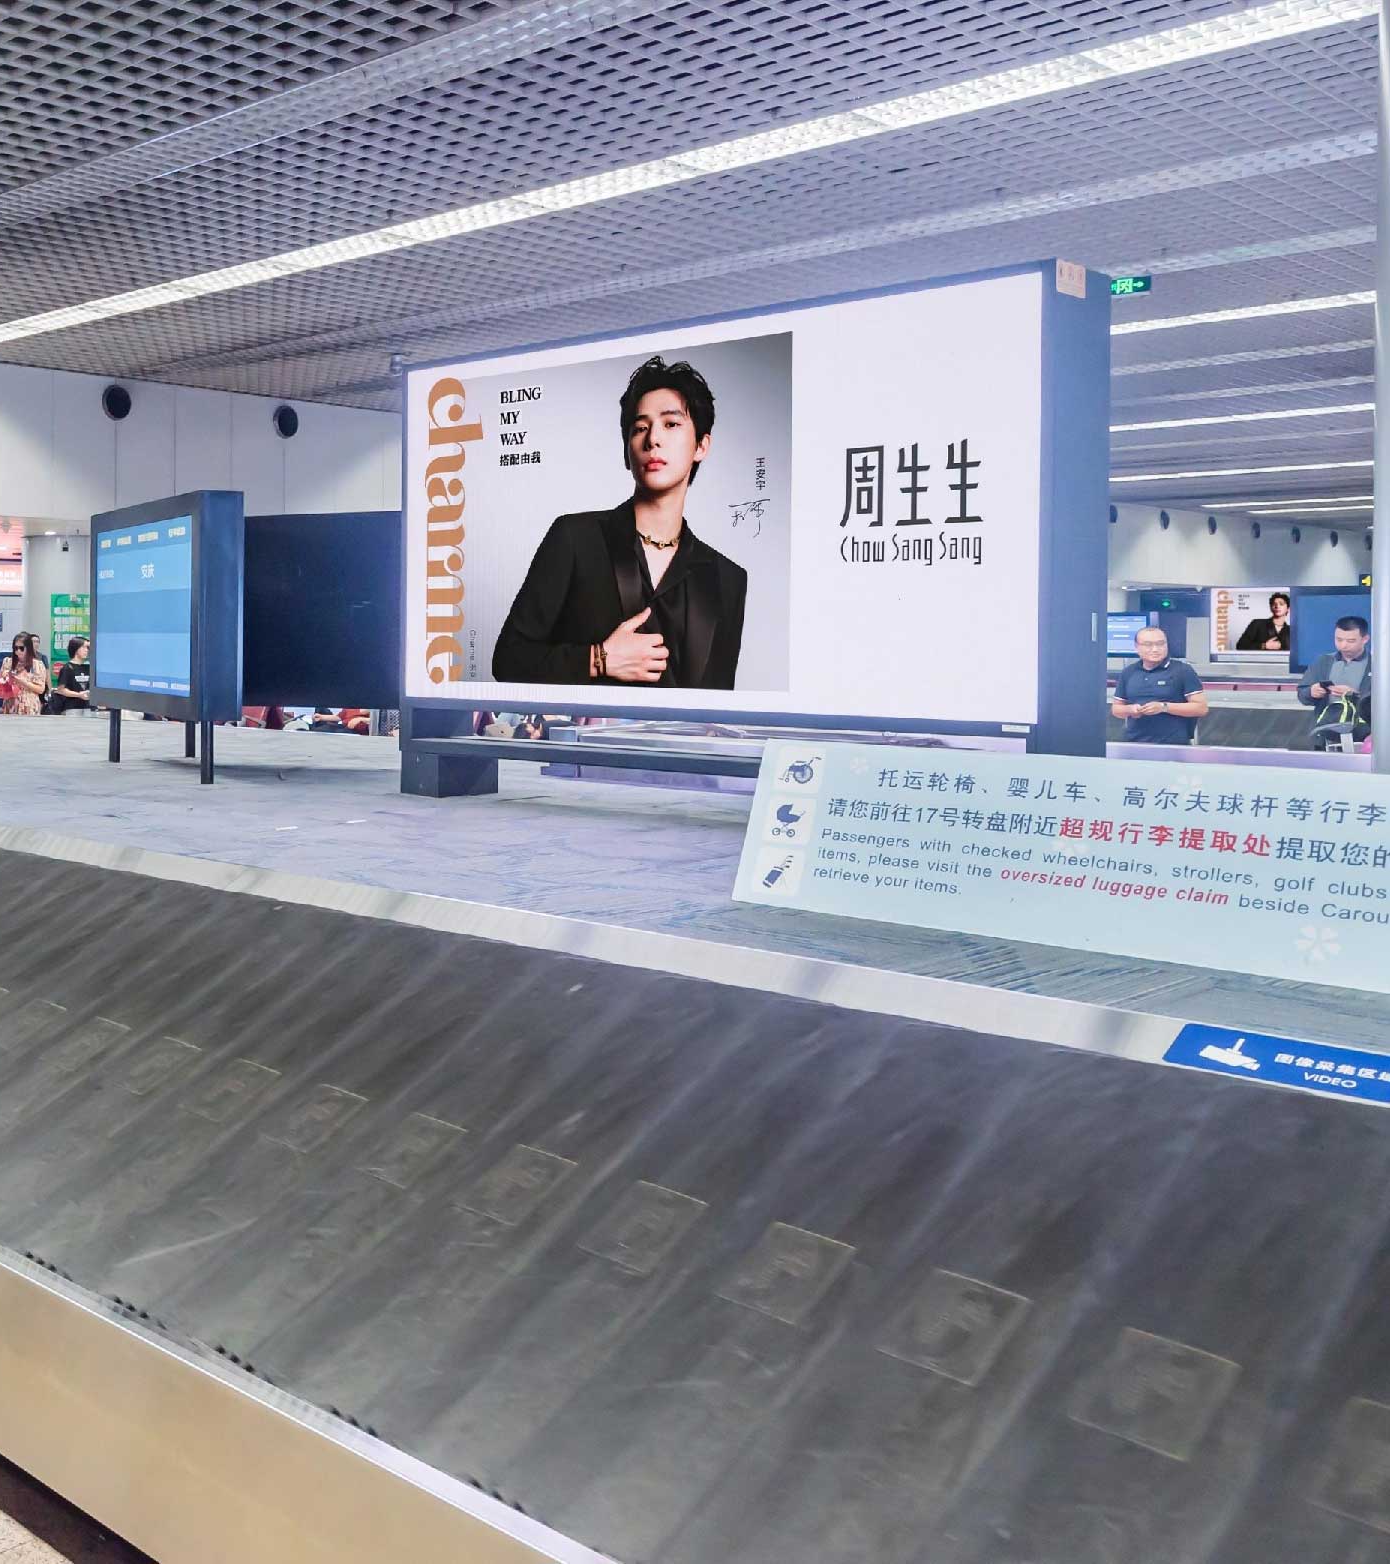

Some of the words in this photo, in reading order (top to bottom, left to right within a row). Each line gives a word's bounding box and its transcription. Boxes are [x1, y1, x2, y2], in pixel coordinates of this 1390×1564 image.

[500, 386, 542, 404] BLING
[499, 410, 520, 425] MY
[499, 431, 527, 446] WAY
[499, 451, 541, 467] 搭配由我
[839, 438, 984, 528] 周生生
[425, 376, 483, 685] charme
[840, 536, 885, 563] Chow
[892, 531, 933, 566] Sang
[939, 531, 982, 565] Sang
[877, 768, 1387, 827] 托运轮椅、婴儿车、高尔夫球杆等行李
[821, 827, 910, 849] Passengers
[920, 838, 952, 854] with
[961, 843, 1033, 862] checked
[1043, 850, 1159, 877] wheelchairs,
[1171, 864, 1260, 889] strollers,
[1273, 876, 1316, 892] golf
[1328, 880, 1388, 900] clubs
[813, 866, 870, 884] retrieve
[874, 874, 910, 889] your
[913, 877, 962, 896] items.
[817, 847, 861, 865] items,
[868, 852, 920, 869] please
[927, 860, 961, 875] visit
[966, 863, 993, 878] the
[1000, 868, 1087, 889] oversized
[1092, 876, 1169, 901] luggage
[1176, 886, 1230, 905] claim
[1239, 893, 1310, 915] beside
[1304, 1071, 1358, 1089] VIDEO
